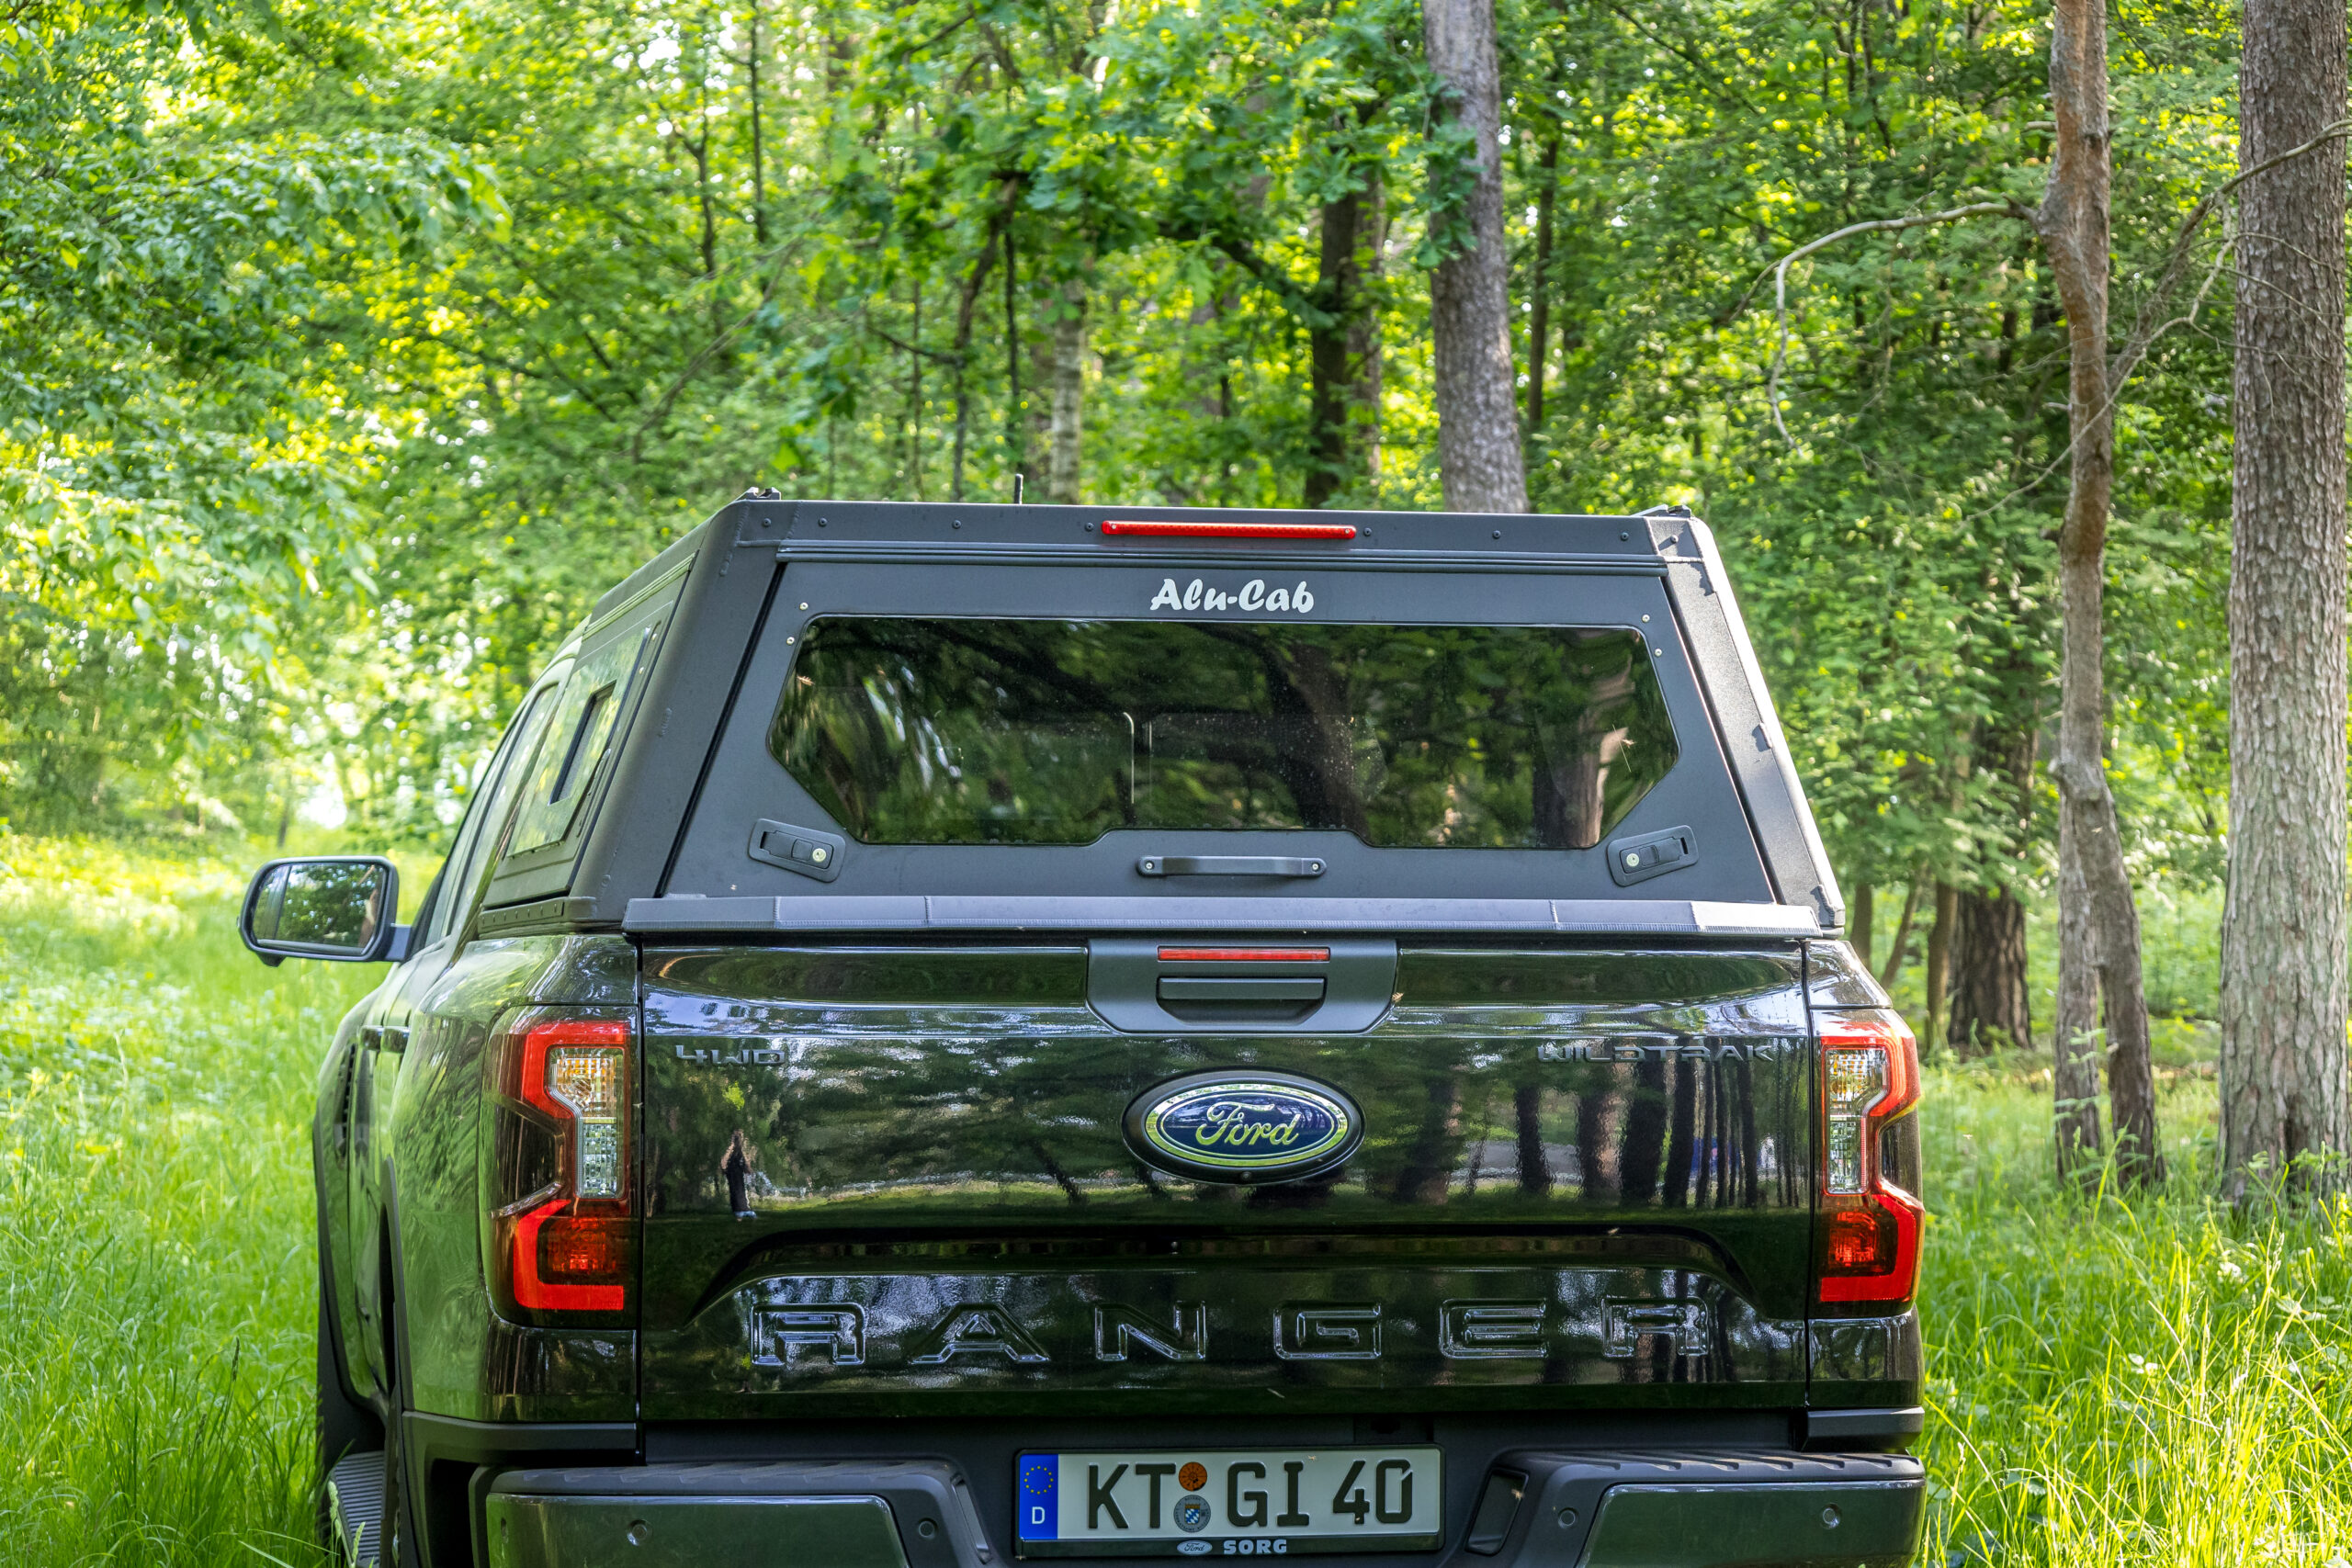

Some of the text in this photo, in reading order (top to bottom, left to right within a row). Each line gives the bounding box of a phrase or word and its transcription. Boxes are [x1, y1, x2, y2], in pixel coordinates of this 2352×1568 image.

[1149, 578, 1315, 614] Alu-Cab
[675, 1044, 786, 1065] 4WD
[1536, 1044, 1774, 1064] WILDTRAK
[1195, 1101, 1302, 1146] Ford
[751, 1295, 1710, 1367] RANGER
[1088, 1462, 1176, 1529] KT
[1227, 1461, 1310, 1527] GI
[1332, 1459, 1414, 1525] 40
[1031, 1506, 1046, 1525] D
[1223, 1539, 1287, 1555] SORG
